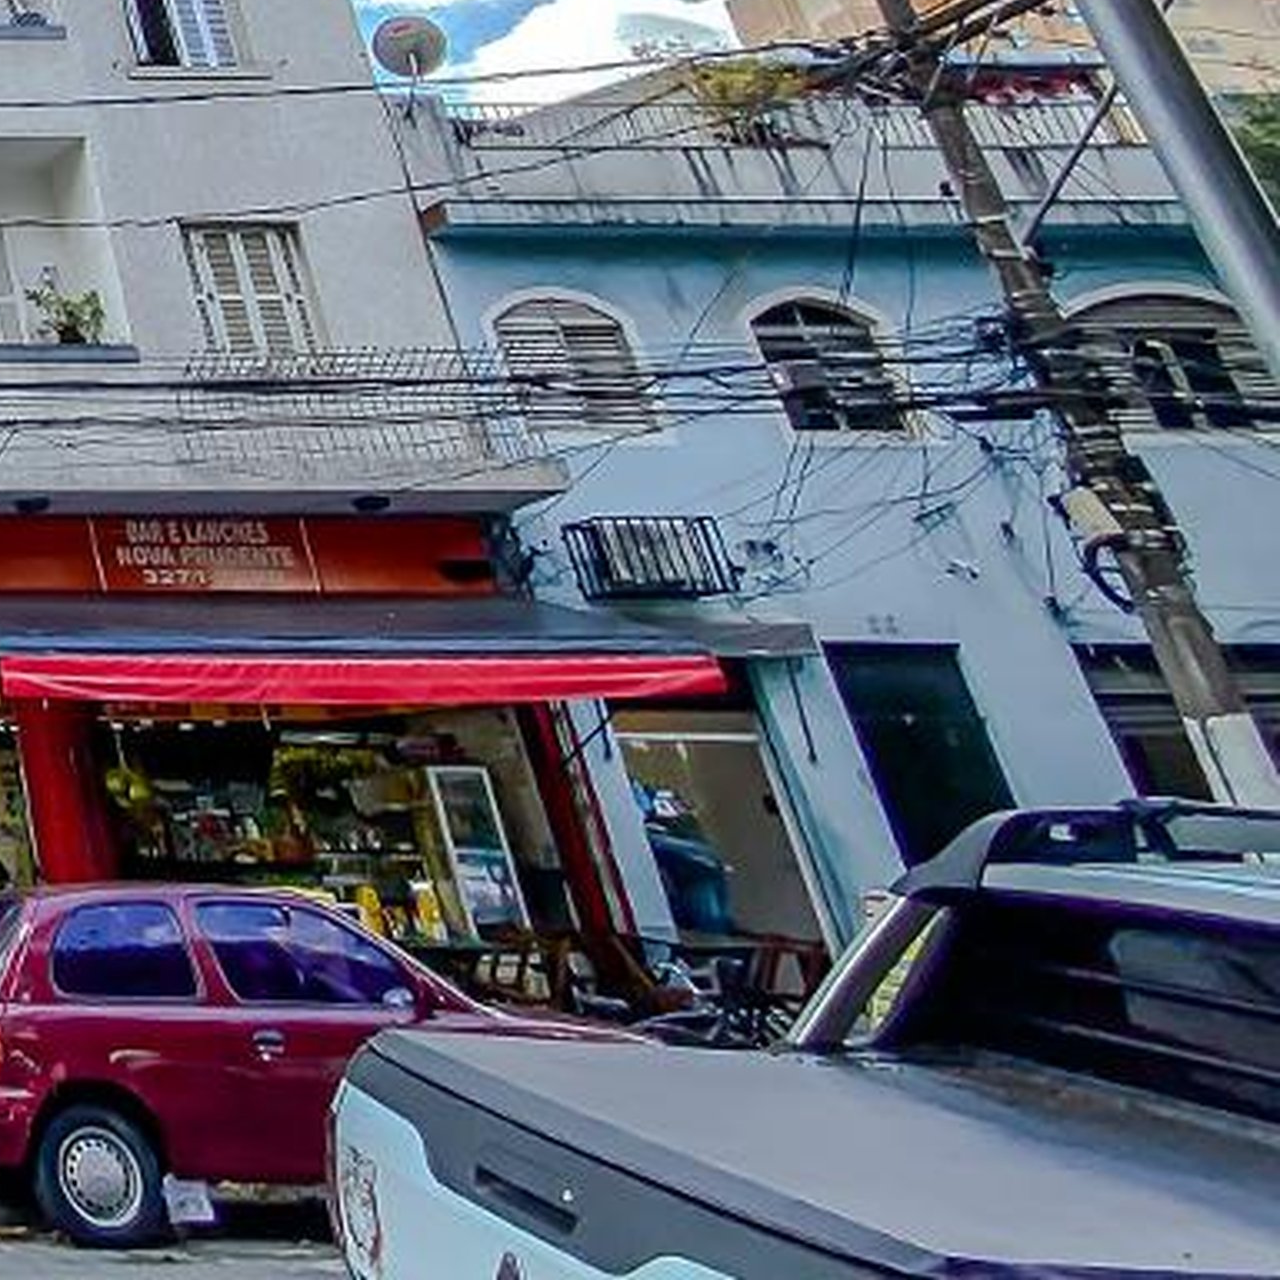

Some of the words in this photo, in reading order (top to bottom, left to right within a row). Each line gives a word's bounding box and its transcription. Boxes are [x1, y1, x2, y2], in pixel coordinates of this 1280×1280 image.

[125, 521, 164, 544] BAR
[166, 522, 182, 543] E
[182, 521, 269, 544] LANCHES
[115, 545, 175, 566] NOVA
[178, 545, 295, 568] PRUDENTE
